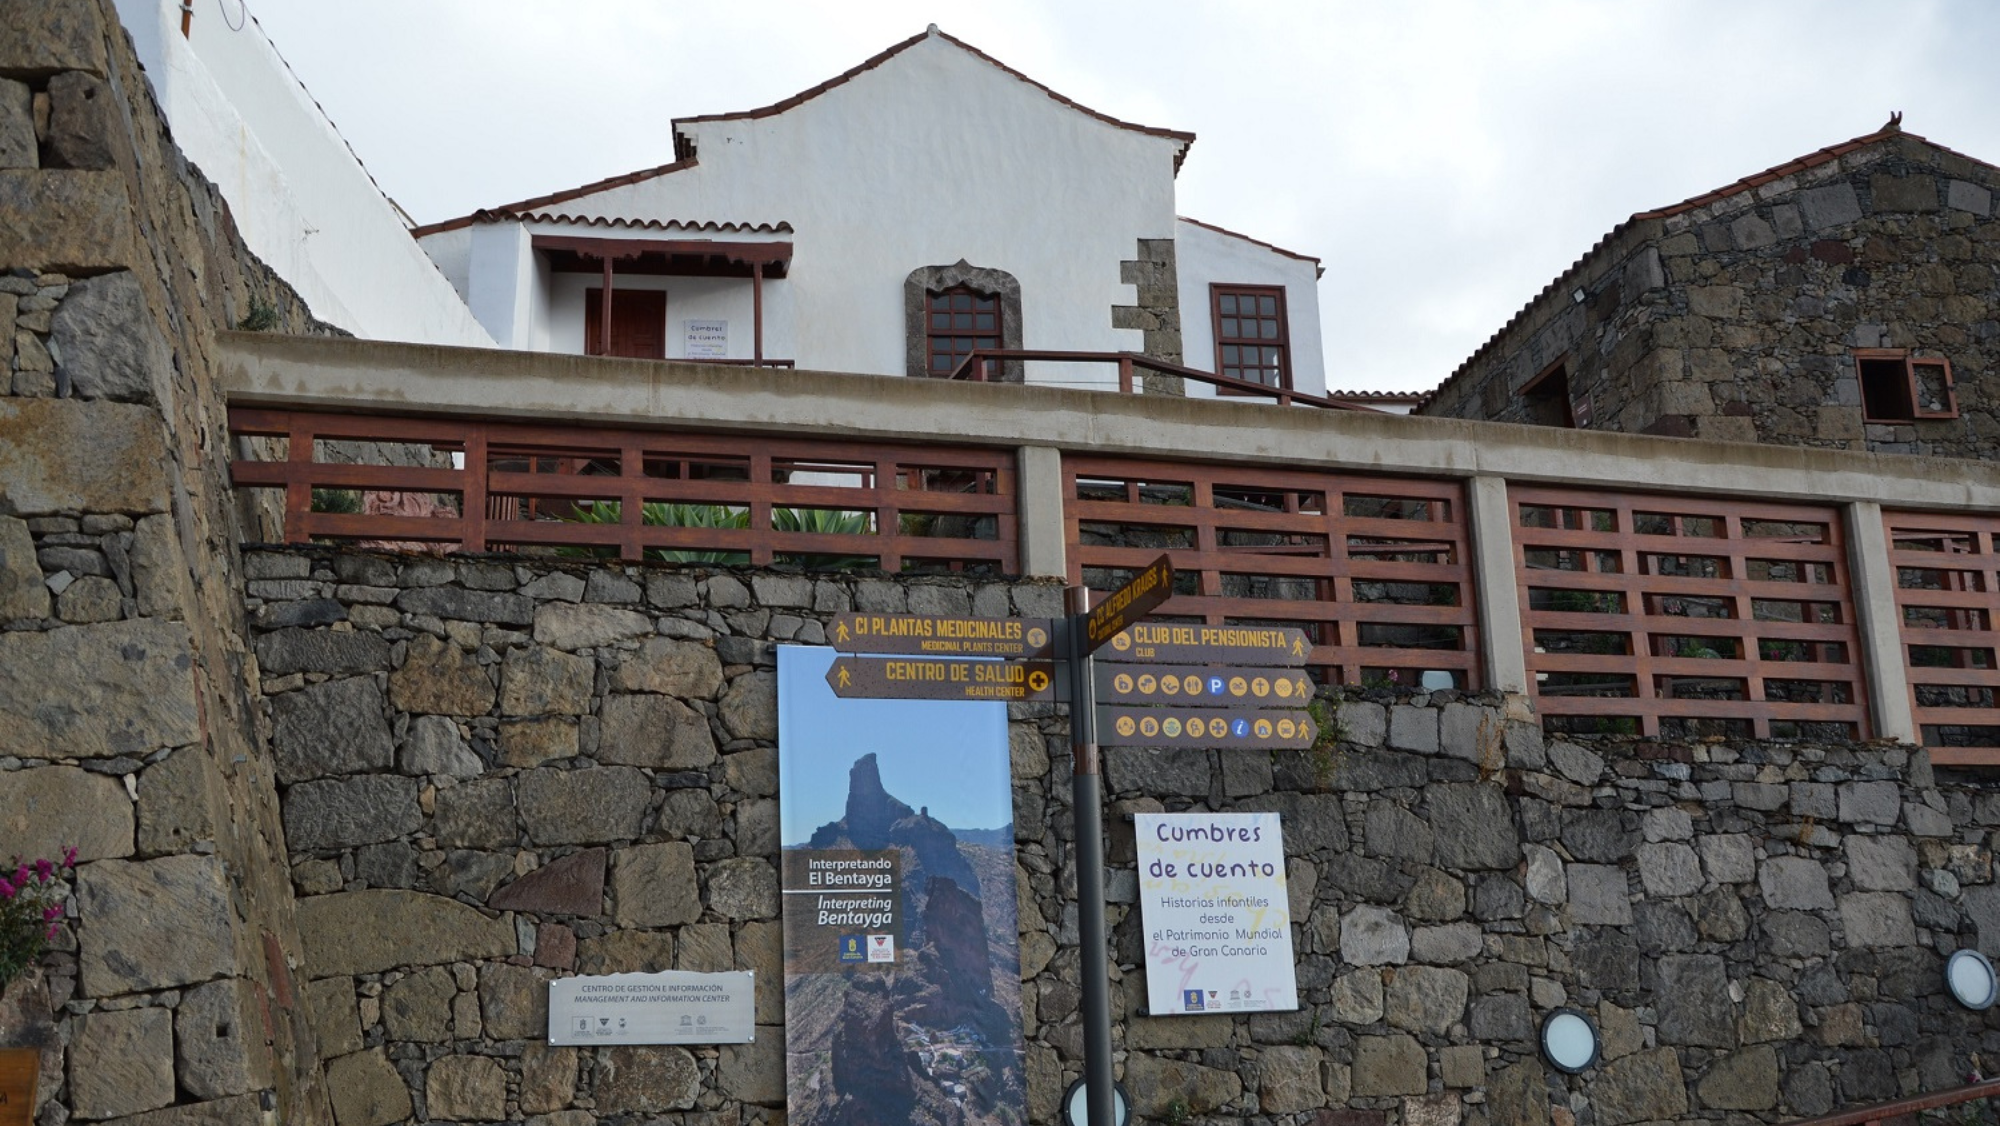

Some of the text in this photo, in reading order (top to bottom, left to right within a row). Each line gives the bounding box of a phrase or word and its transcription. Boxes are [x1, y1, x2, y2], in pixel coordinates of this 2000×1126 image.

[1105, 585, 1132, 619] ALFREDO
[1132, 566, 1158, 600] KRAUSS
[855, 617, 1022, 639] CI PLANTAS MEDICINALES
[1134, 626, 1287, 648] CLUB DEL PENSIONISTA
[921, 640, 1024, 653] MEDICINAL PLANTS CENTER
[1135, 647, 1155, 657] CLUB
[886, 661, 1025, 683] CENTRO DE SALUD
[965, 685, 1025, 697] HEALTH CENTER
[1156, 823, 1261, 843] Cumbres
[808, 858, 892, 871] Interpretando
[1149, 858, 1274, 878] de cuento
[808, 871, 892, 888] El Bentayga
[818, 894, 892, 911] Interpreting
[1160, 896, 1269, 908] Historias infantiles
[818, 910, 893, 928] Bentayga
[1199, 913, 1234, 924] desde
[1152, 928, 1283, 941] el Patrimonio Mundial
[1171, 944, 1268, 957] de Gran Canaria
[581, 985, 614, 993] CENTRO
[614, 985, 626, 993] DE
[662, 985, 667, 993] E
[574, 994, 730, 1003] MANAGEMENT AND INFORMATION CENTER
